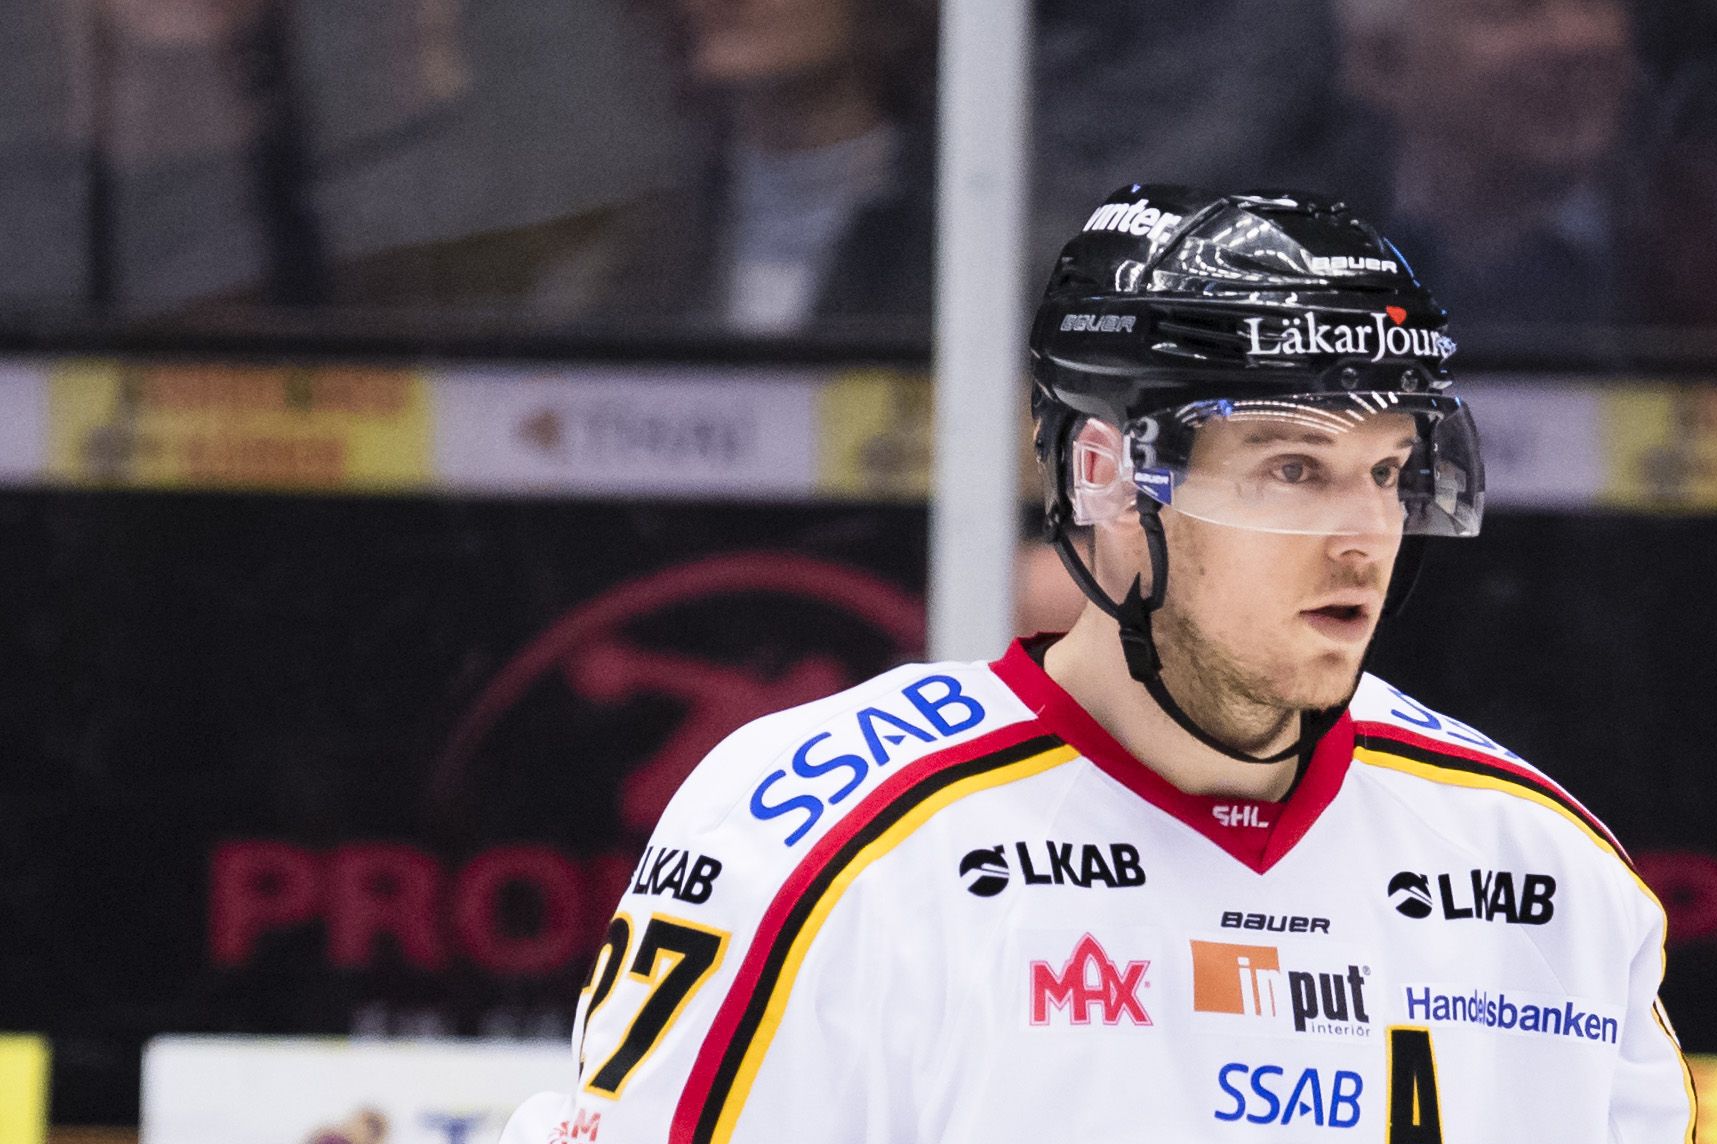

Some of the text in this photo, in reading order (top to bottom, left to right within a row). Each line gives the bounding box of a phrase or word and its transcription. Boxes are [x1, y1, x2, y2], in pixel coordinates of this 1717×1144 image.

[749, 674, 986, 847] SSAB
[1212, 805, 1269, 828] SHL
[632, 846, 723, 904] LKAB
[1018, 842, 1146, 889] LKAB
[1220, 911, 1331, 934] BAUER
[1029, 931, 1153, 1026] MAX
[1311, 1022, 1371, 1037] interiör
[1213, 1062, 1364, 1128] SSAB
